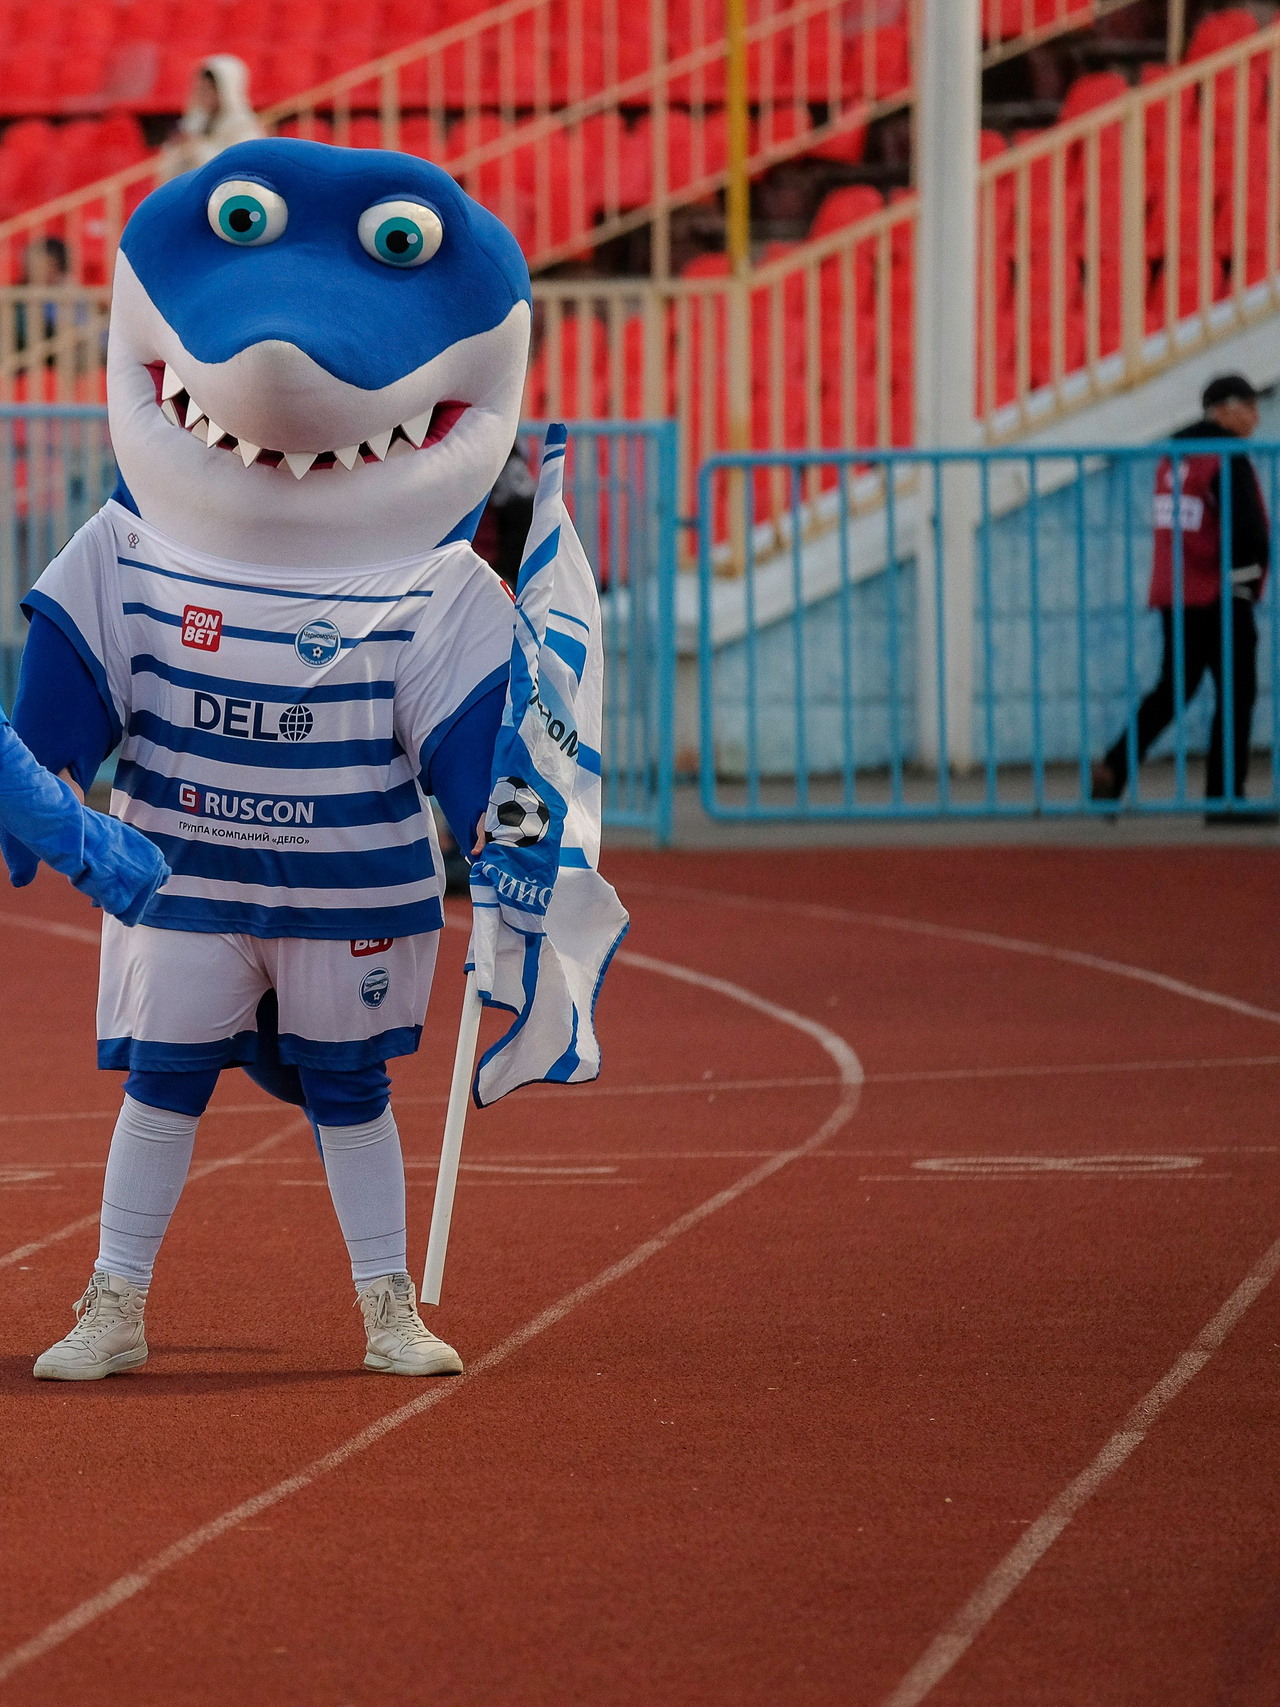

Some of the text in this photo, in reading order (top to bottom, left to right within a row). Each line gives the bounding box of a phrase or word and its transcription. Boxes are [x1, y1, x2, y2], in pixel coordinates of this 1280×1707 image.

[184, 610, 220, 630] FON
[183, 625, 219, 646] BET
[205, 792, 315, 824] RUSCON
[179, 821, 210, 834] ГРУППА
[211, 828, 270, 842] КОМПАНИЙ
